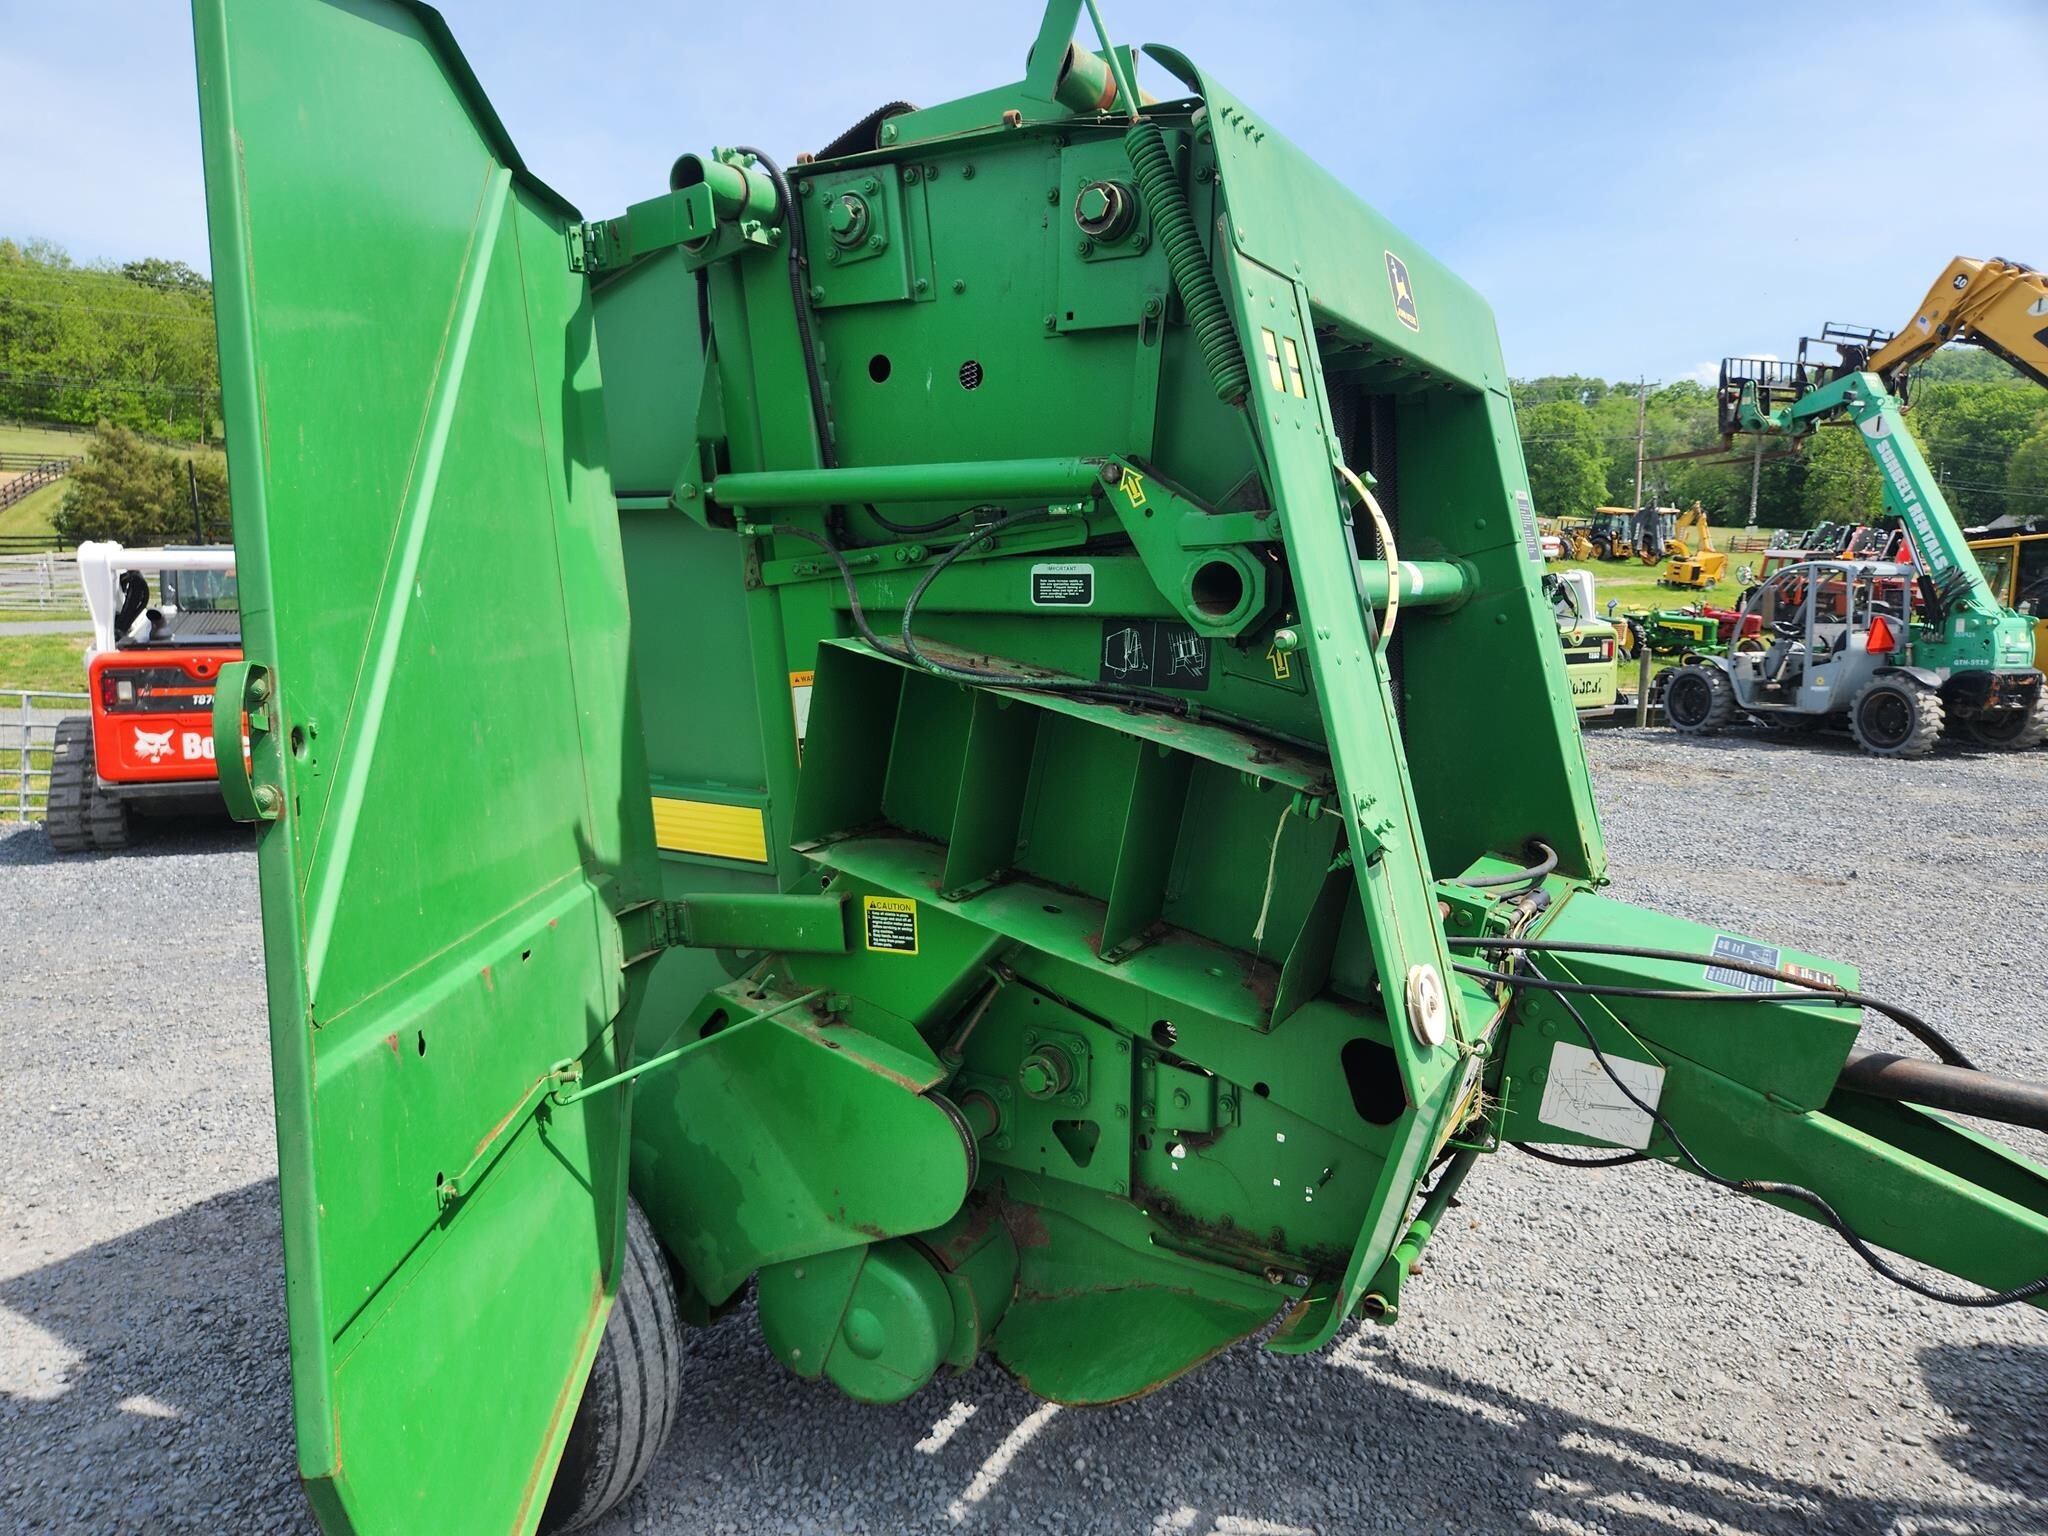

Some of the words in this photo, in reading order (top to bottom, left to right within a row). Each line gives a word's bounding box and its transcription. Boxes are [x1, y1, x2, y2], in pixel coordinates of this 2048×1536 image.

[1954, 276, 1968, 288] 10
[1876, 439, 1917, 503] SUNBELT
[1907, 502, 1949, 570] RENTALS
[877, 902, 911, 911] CAUTION
